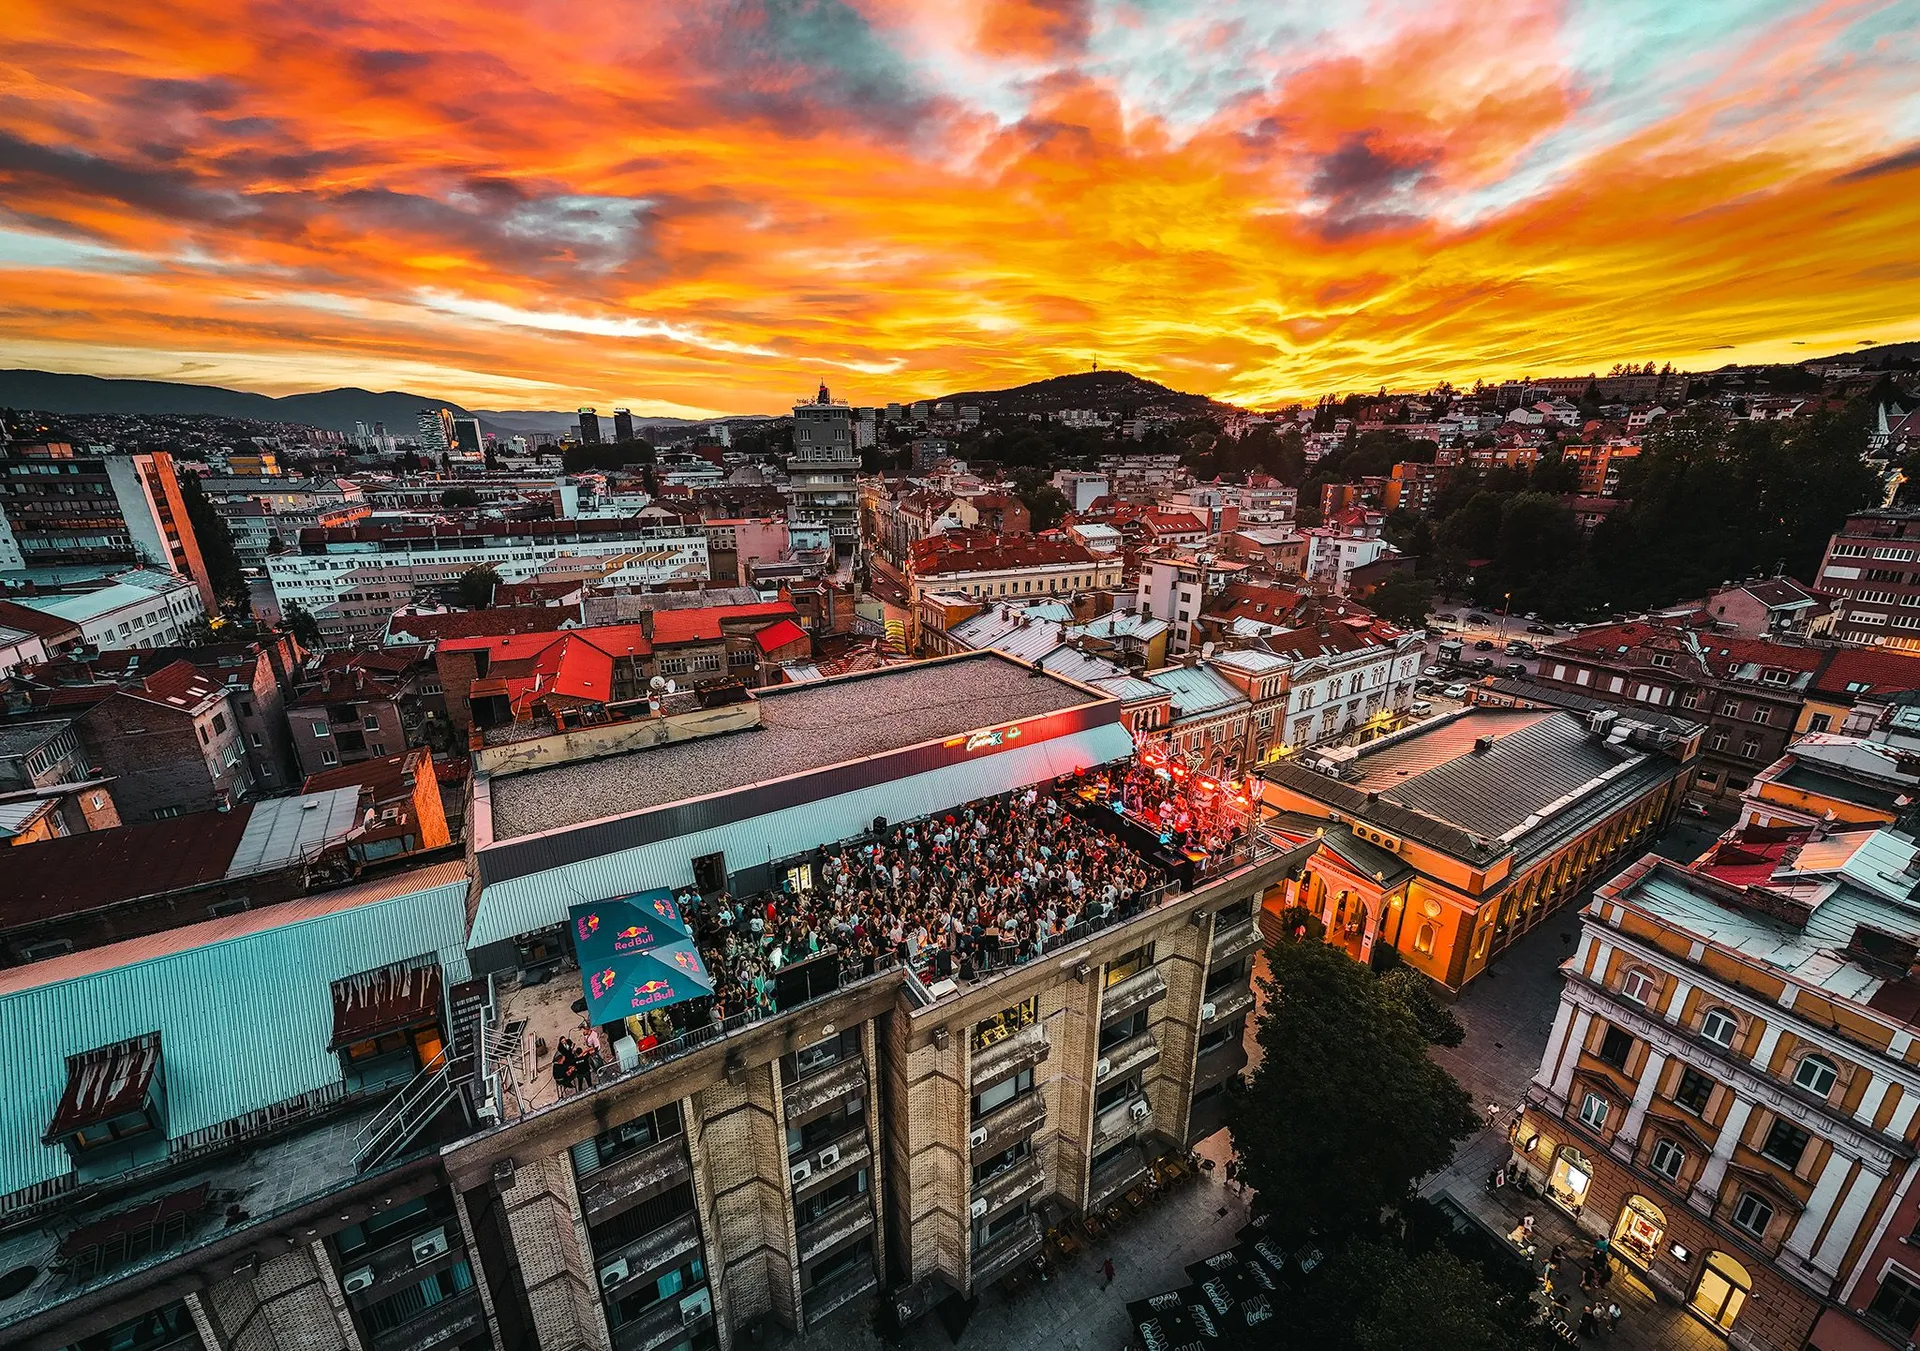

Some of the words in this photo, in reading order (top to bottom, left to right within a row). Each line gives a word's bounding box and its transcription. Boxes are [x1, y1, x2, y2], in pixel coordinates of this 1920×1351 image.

[614, 937, 635, 951] Red
[635, 934, 654, 945] Bull
[631, 996, 653, 1008] Red
[653, 988, 675, 1001] Bull
